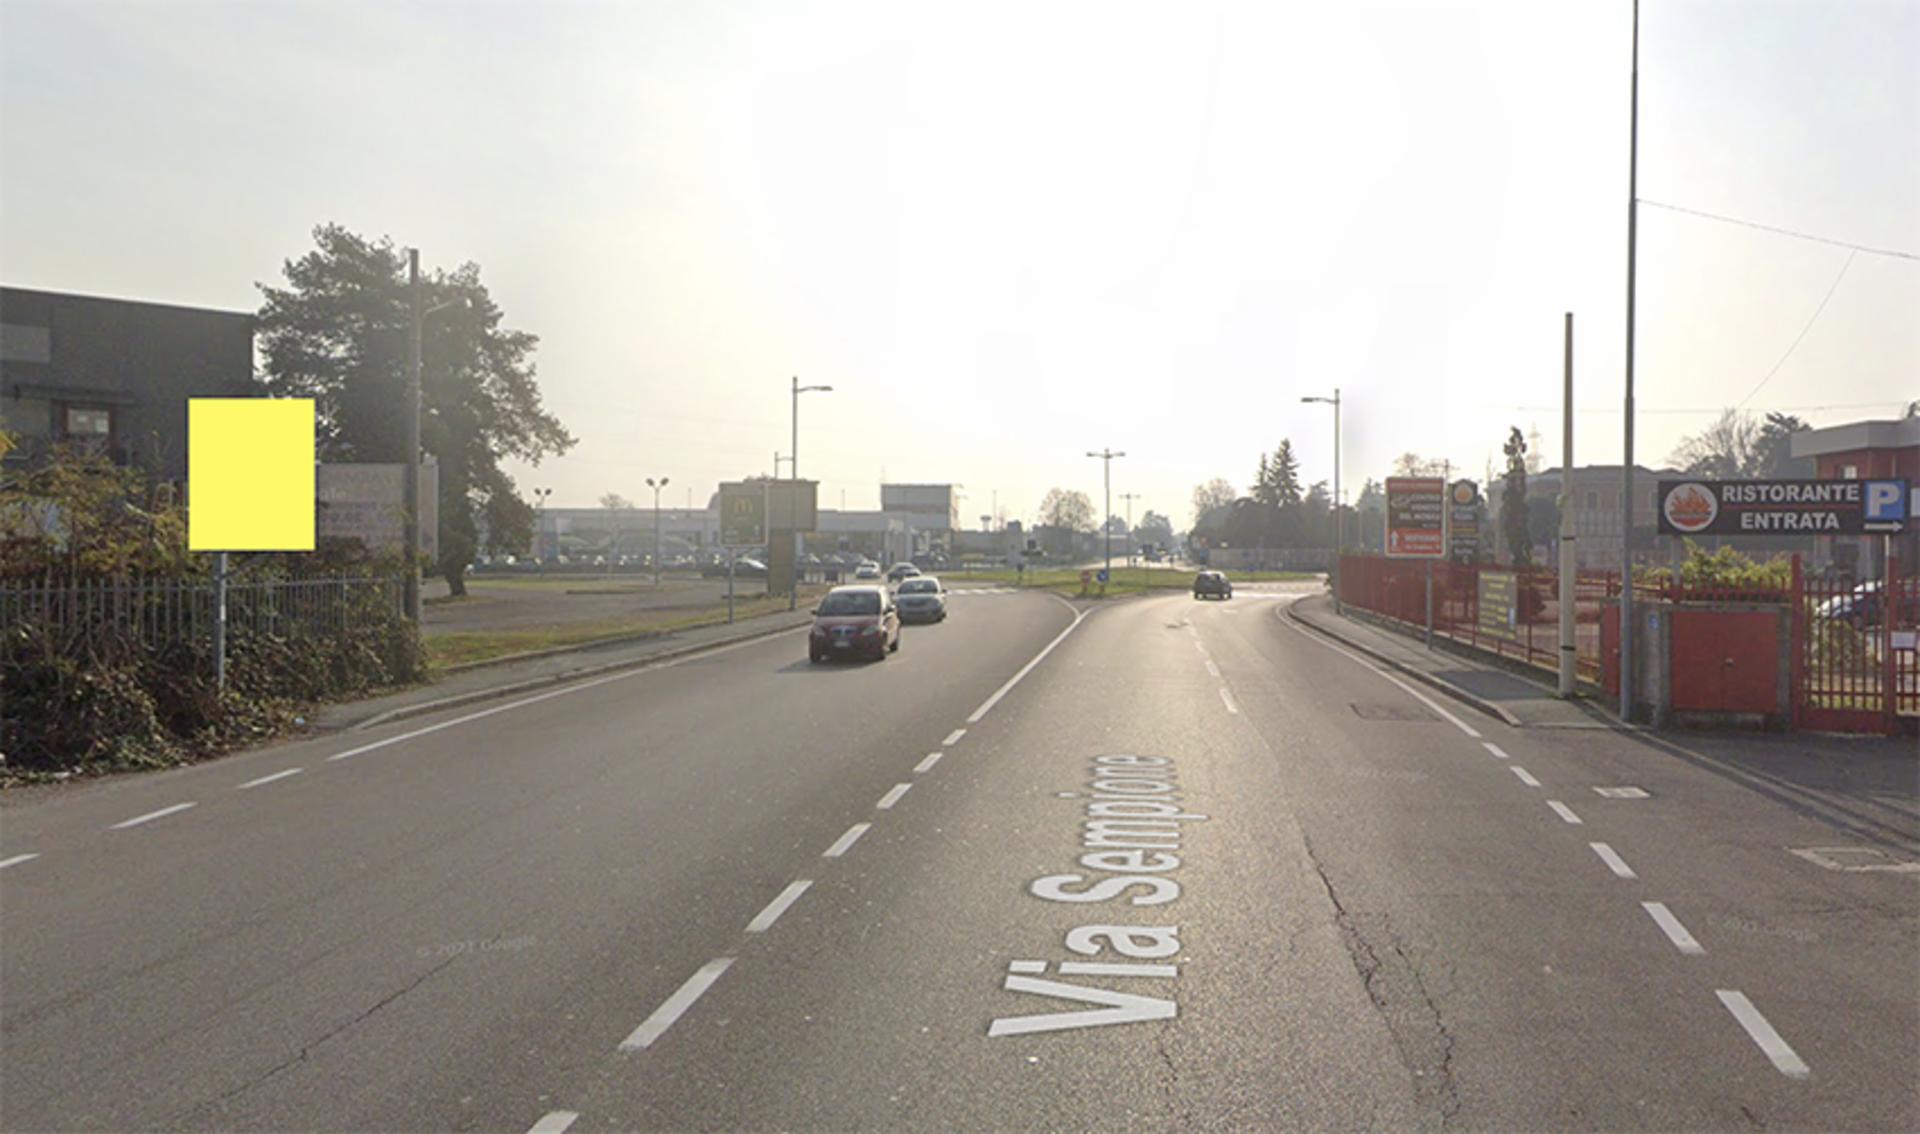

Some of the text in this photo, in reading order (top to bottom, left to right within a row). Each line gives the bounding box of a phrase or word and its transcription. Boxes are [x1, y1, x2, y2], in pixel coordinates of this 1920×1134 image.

[1722, 484, 1859, 502] RISTORANTE
[1869, 482, 1900, 517] P
[1740, 512, 1840, 530] ENTRATA
